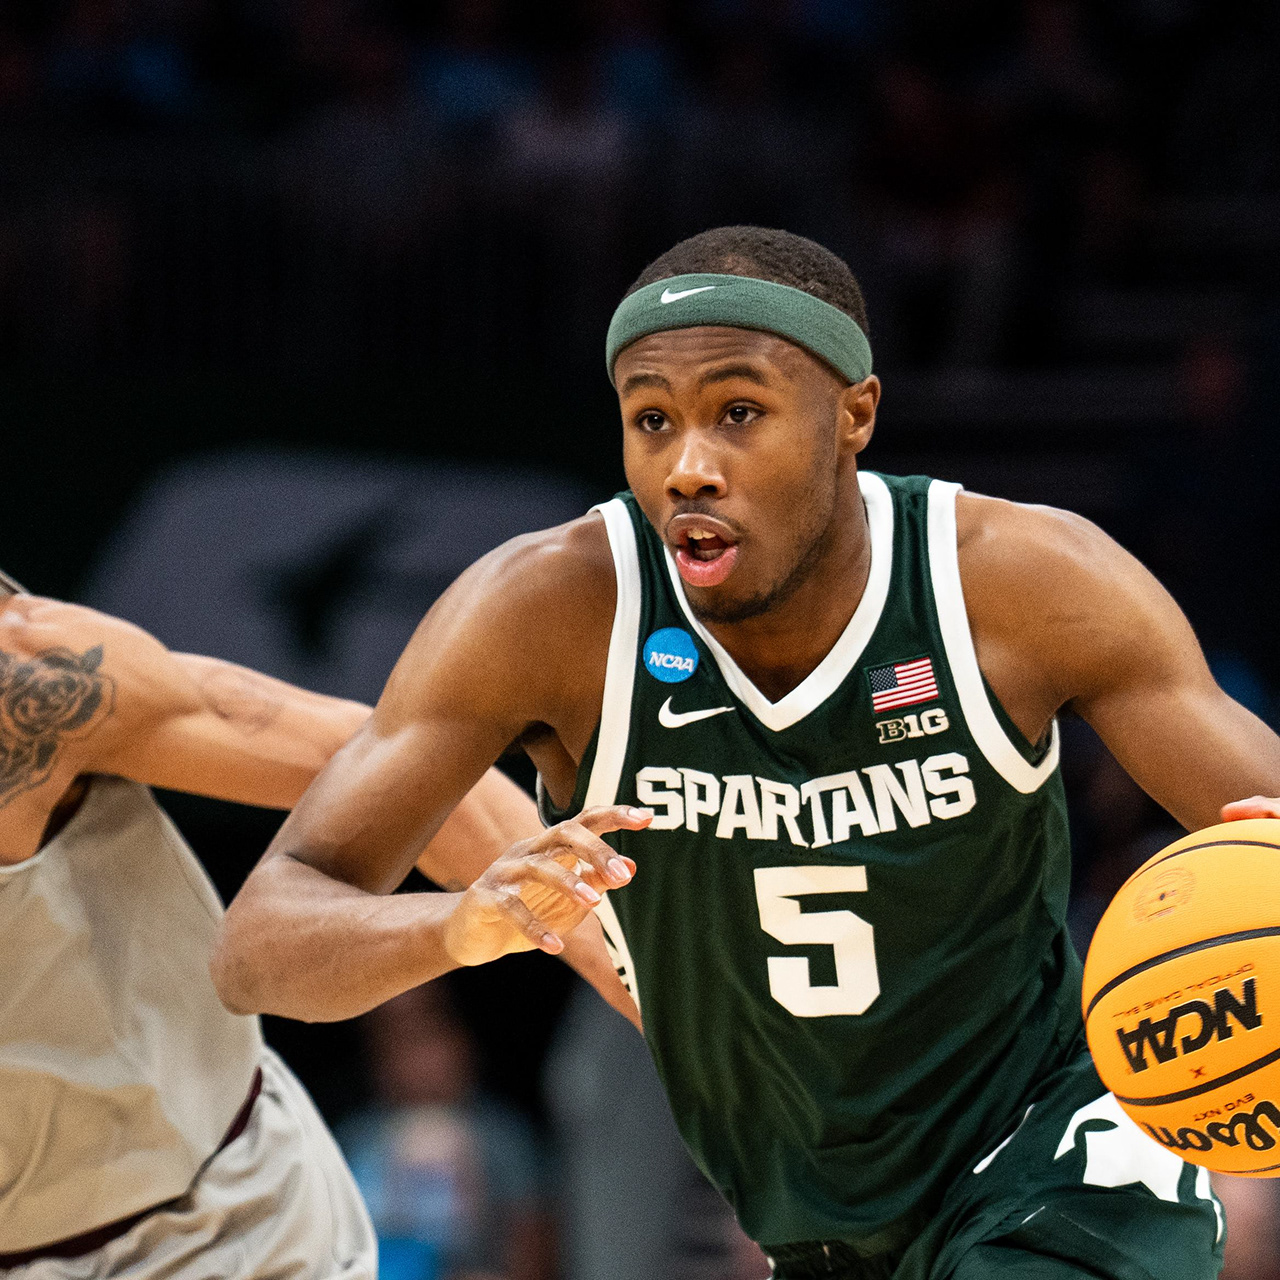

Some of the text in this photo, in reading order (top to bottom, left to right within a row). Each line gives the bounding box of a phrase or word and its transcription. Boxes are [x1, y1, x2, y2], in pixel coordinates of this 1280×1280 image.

[649, 651, 695, 674] NCAA
[635, 752, 977, 849] SPARTANS
[753, 865, 881, 1018] 5
[1184, 963, 1255, 993] OFFICIAL
[1116, 977, 1263, 1074] NCAA
[1194, 1093, 1255, 1122] EVO NXT
